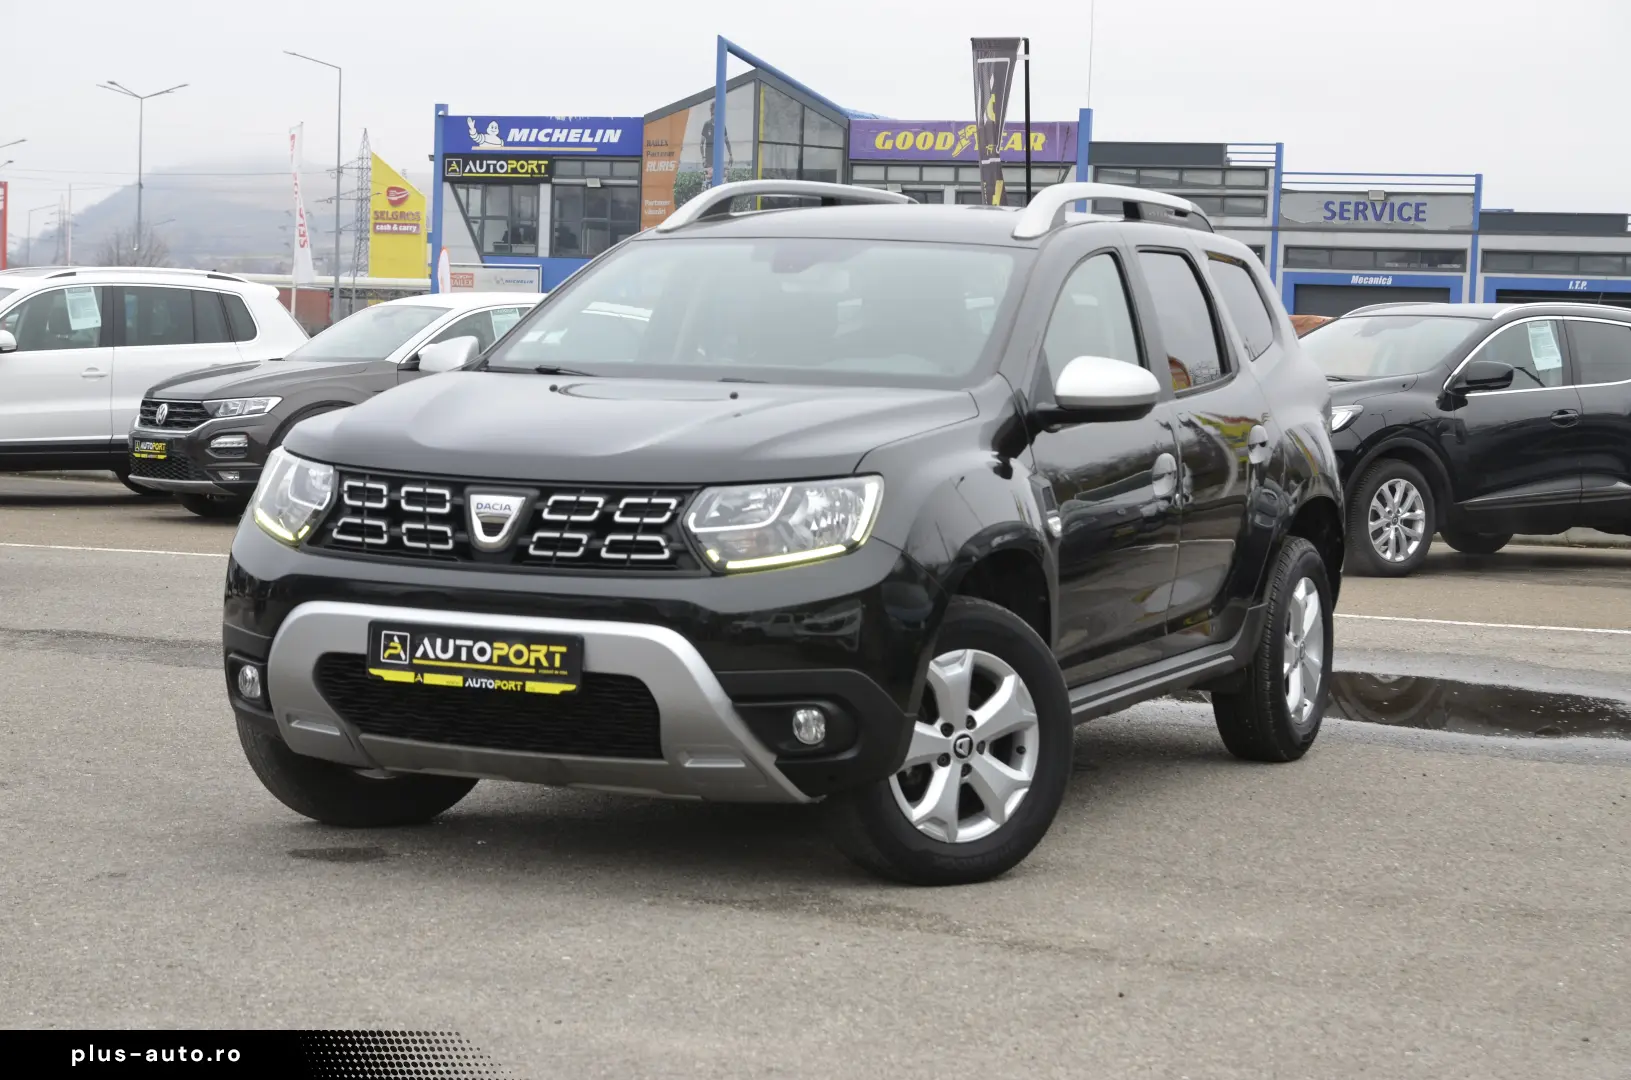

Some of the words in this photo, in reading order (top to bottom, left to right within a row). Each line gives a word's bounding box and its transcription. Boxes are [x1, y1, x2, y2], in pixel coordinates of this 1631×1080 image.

[506, 128, 622, 143] MICHELIN
[464, 160, 549, 174] AUTOPORT
[373, 210, 421, 222] SELGROS
[1323, 200, 1428, 222] SERVICE
[399, 225, 418, 233] carry
[1350, 275, 1393, 286] Mecanică
[1568, 280, 1588, 290] I.T.P.
[140, 441, 168, 451] AUTOPORT
[475, 502, 513, 512] DACIA
[414, 637, 568, 668] AUTOPORT
[464, 677, 524, 692] AUTOPORT
